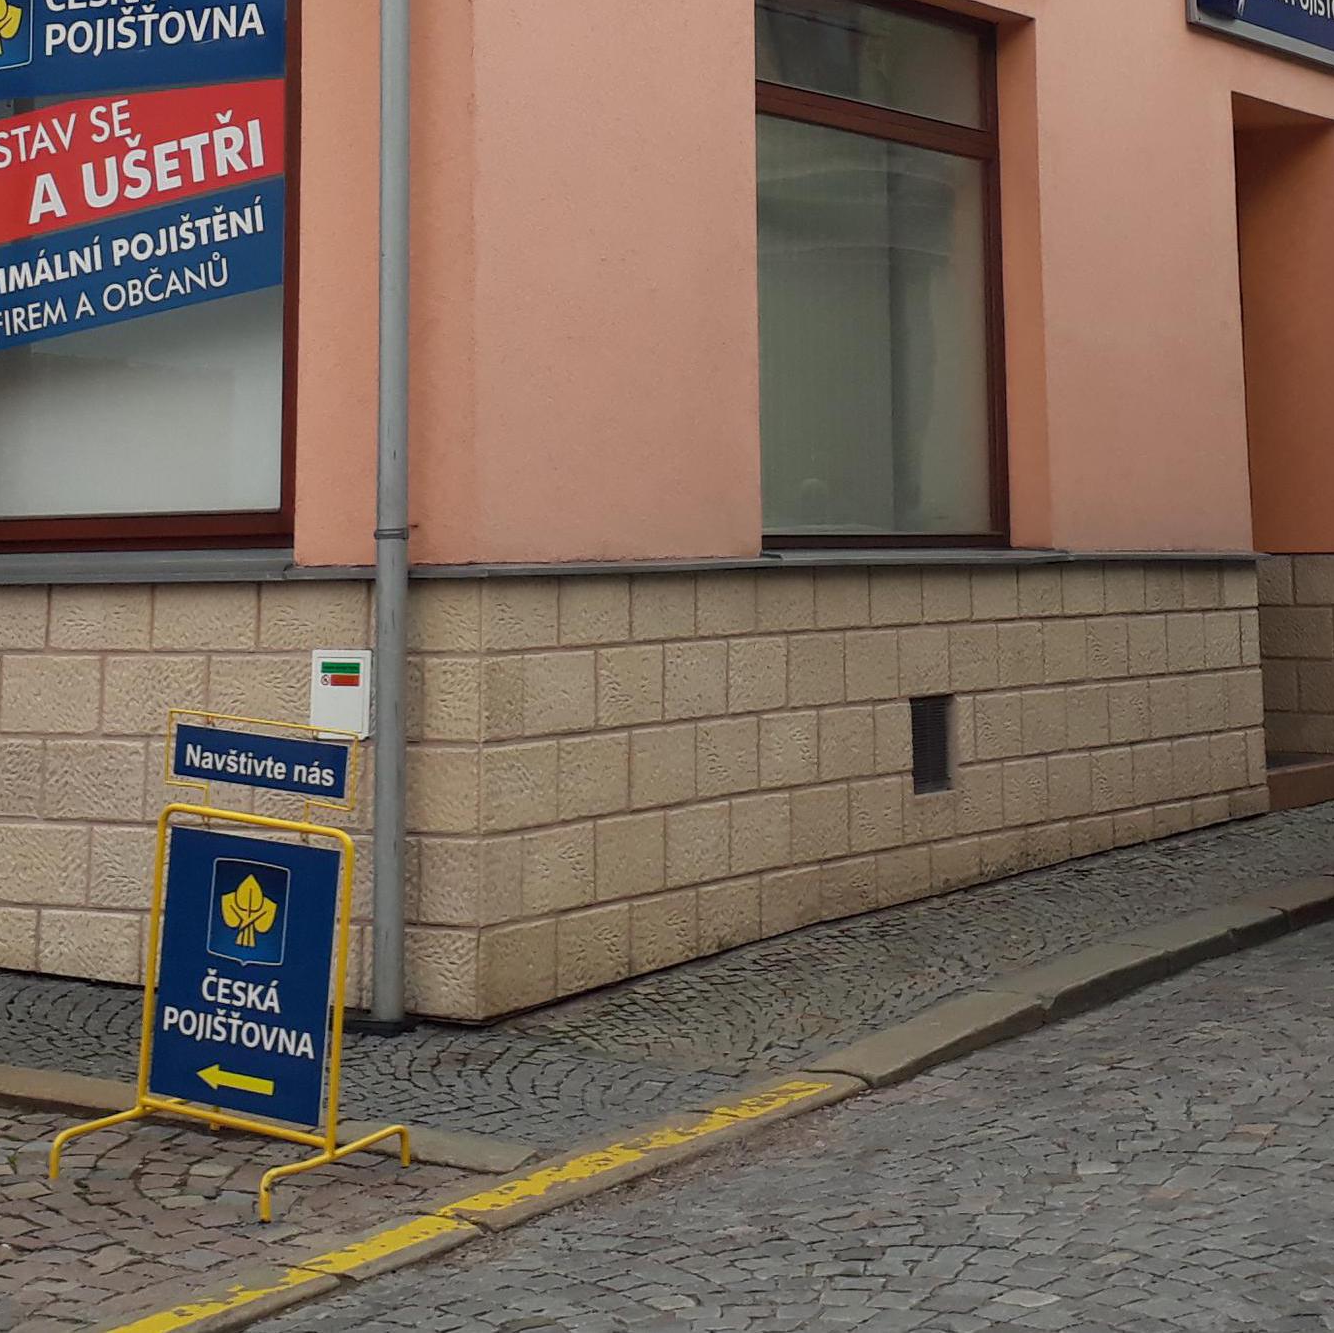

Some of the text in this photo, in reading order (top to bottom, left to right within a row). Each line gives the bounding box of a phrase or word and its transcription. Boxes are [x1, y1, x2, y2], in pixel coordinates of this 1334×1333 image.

[45, 3, 265, 58] POJIŠŤOVNA
[90, 100, 133, 141] SE
[28, 110, 265, 224] A UŠETŘI
[112, 196, 265, 272] POJIŠTĚNÍ
[75, 290, 95, 318] A
[102, 253, 229, 312] OBČANŮ
[185, 745, 335, 787] Navštivte nás
[201, 968, 281, 1014] ČESKÁ
[162, 1006, 315, 1059] POJIŠŤOVNA
